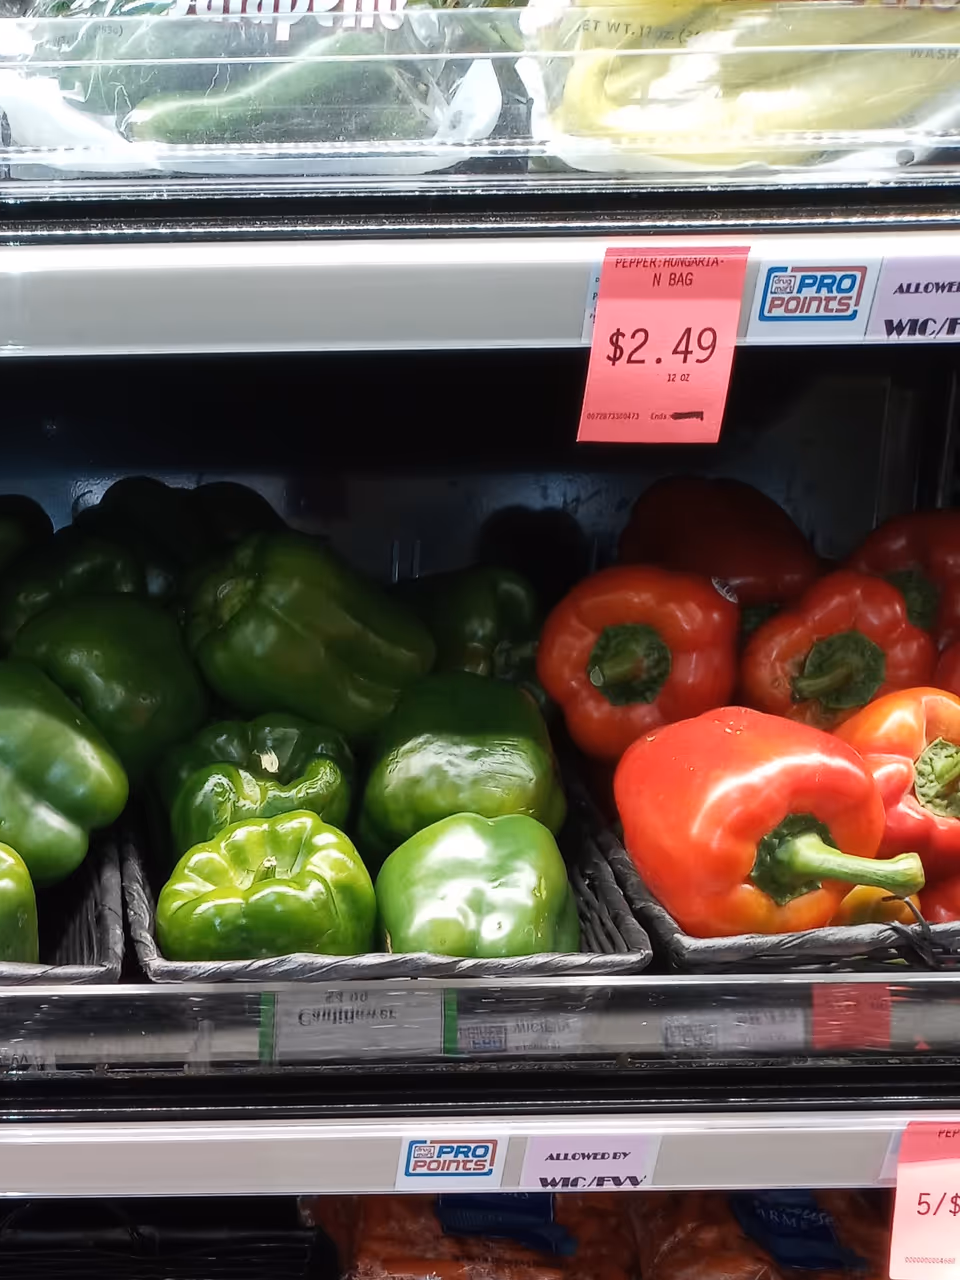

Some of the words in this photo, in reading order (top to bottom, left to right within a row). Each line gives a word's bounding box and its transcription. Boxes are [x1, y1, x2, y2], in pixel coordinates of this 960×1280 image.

[652, 273, 662, 287] N
[668, 272, 694, 286] BAG
[774, 277, 792, 286] drug
[796, 274, 857, 294] PRO
[773, 285, 794, 293] mart
[767, 296, 853, 314] POINTS
[606, 327, 718, 366] $2.49
[667, 373, 676, 382] 12
[680, 373, 690, 382] OZ
[436, 1144, 490, 1158] PRO
[544, 1152, 610, 1162] ALLOWED
[612, 1152, 631, 1160] BY
[412, 1160, 488, 1171] POINTS
